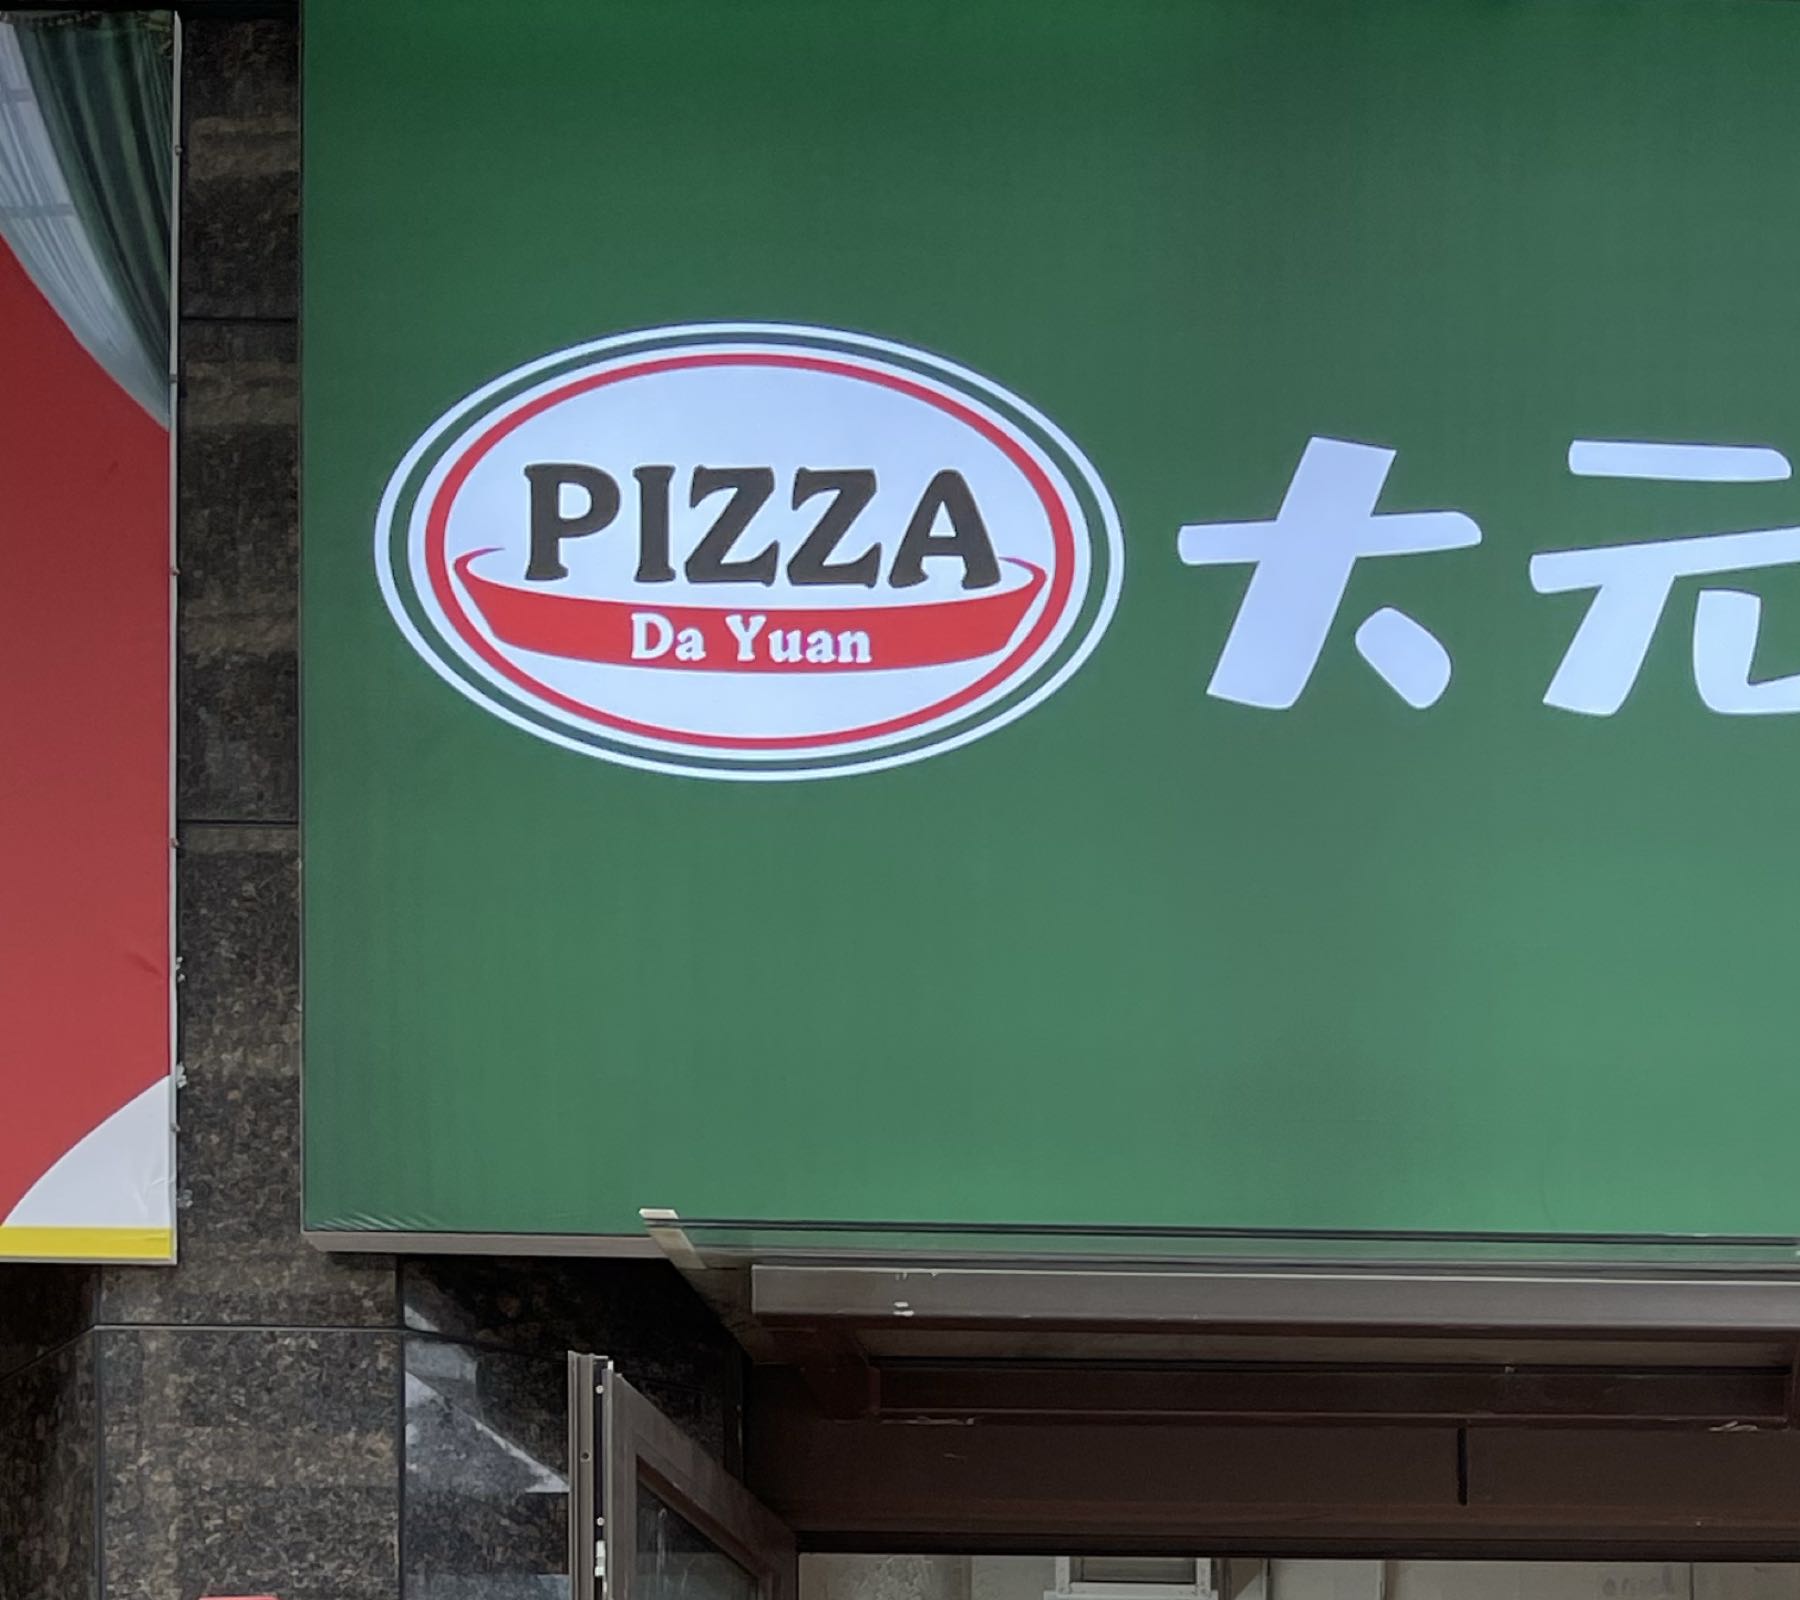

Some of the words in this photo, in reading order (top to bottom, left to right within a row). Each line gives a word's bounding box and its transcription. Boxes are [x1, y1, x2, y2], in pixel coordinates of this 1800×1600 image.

[522, 463, 1000, 591] PIZZA
[630, 612, 707, 664] Da
[723, 612, 873, 665] Yuan
